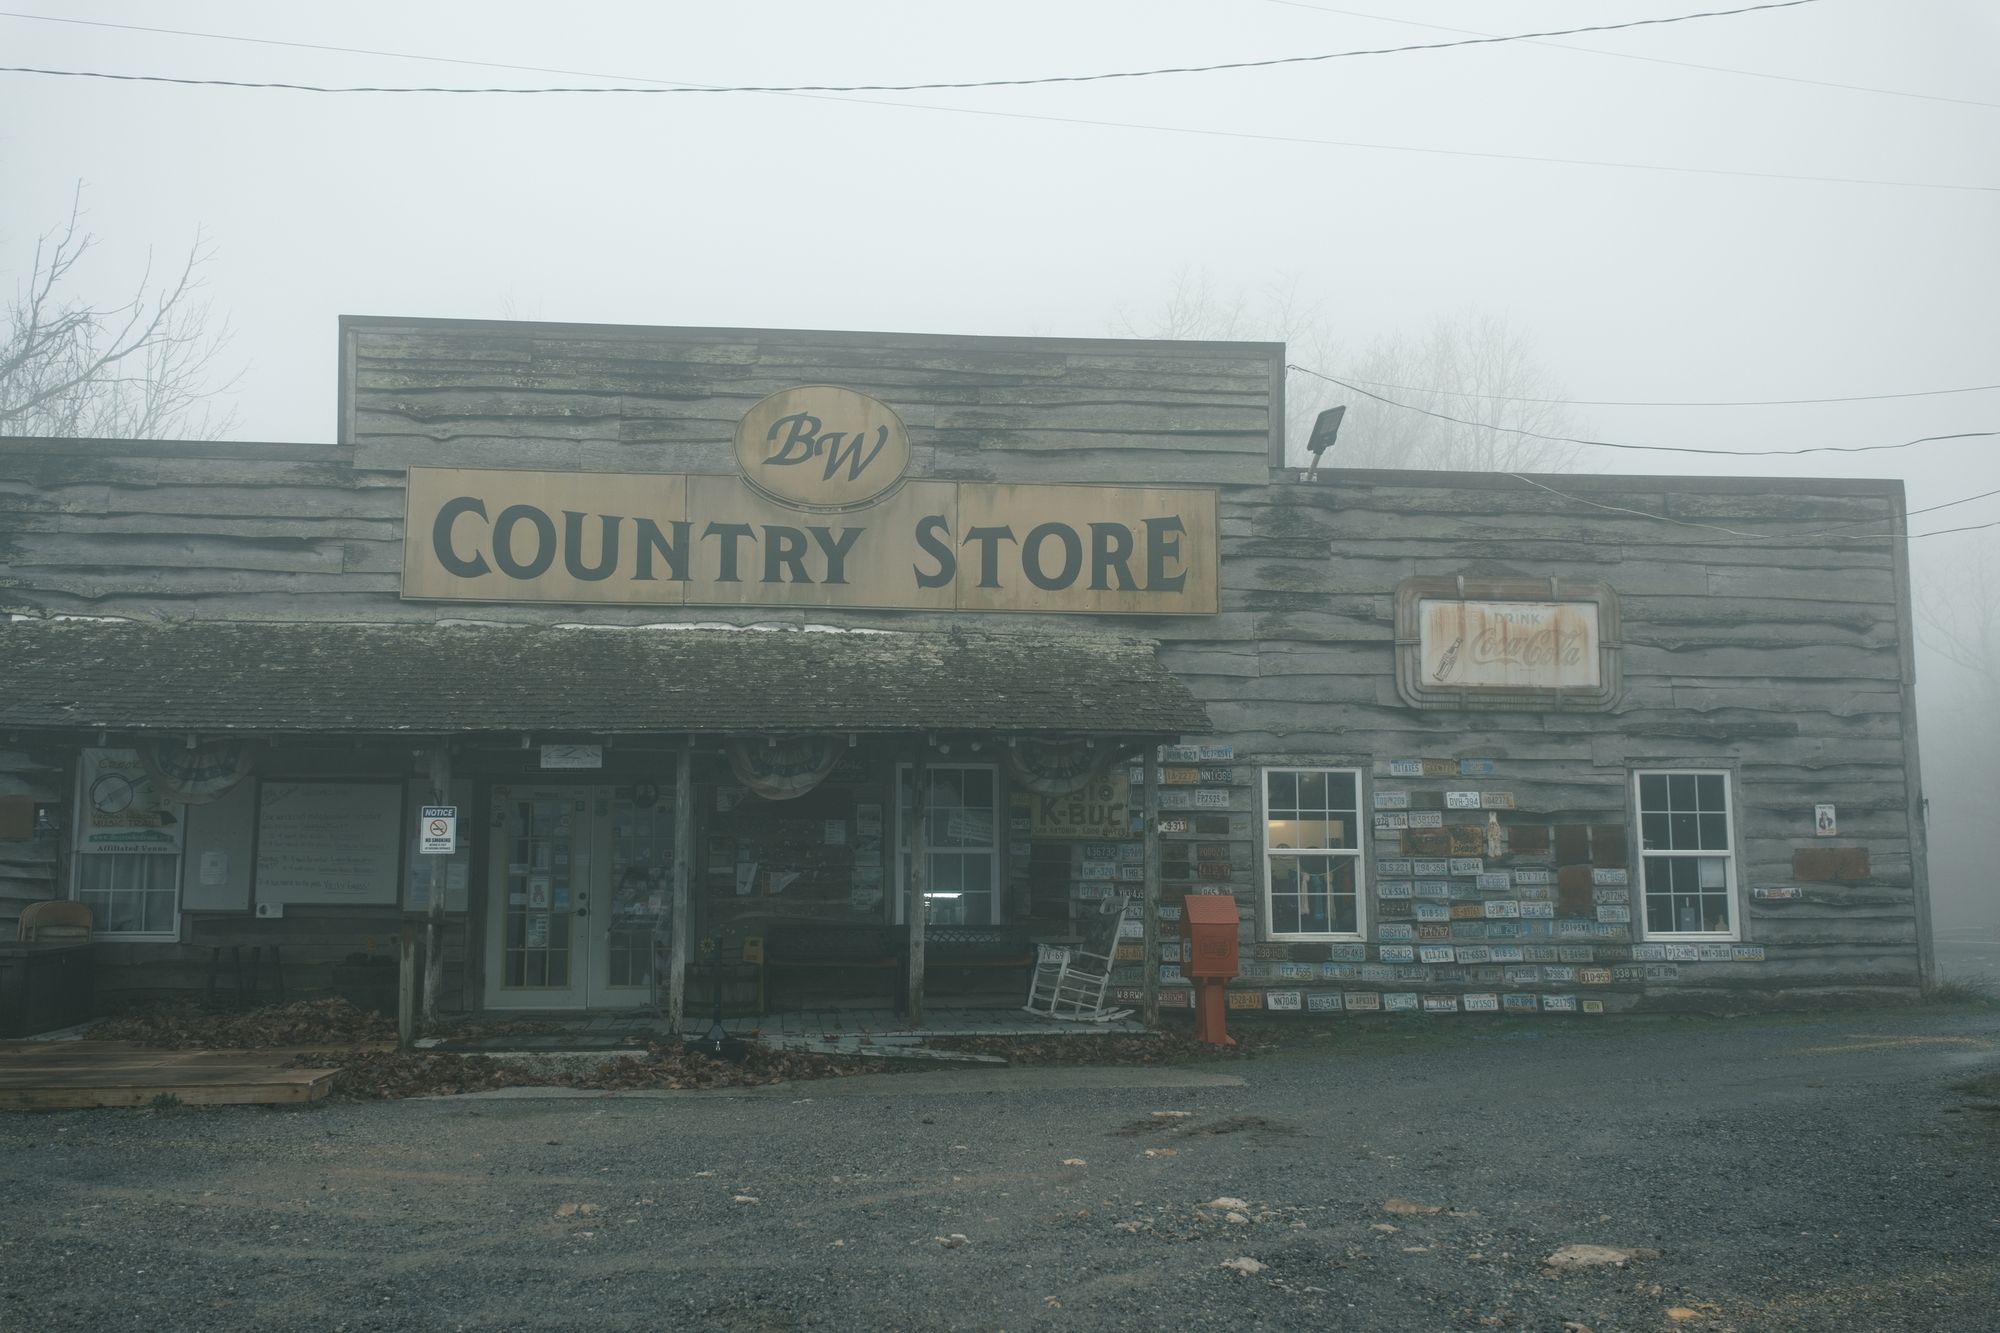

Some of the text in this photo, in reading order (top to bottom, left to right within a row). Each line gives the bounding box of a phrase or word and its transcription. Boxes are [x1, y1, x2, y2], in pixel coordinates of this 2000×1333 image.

[762, 411, 889, 482] BW
[432, 496, 1190, 594] COUNTRY STORE
[1494, 612, 1540, 625] DRINK
[424, 808, 454, 817] NOTICE
